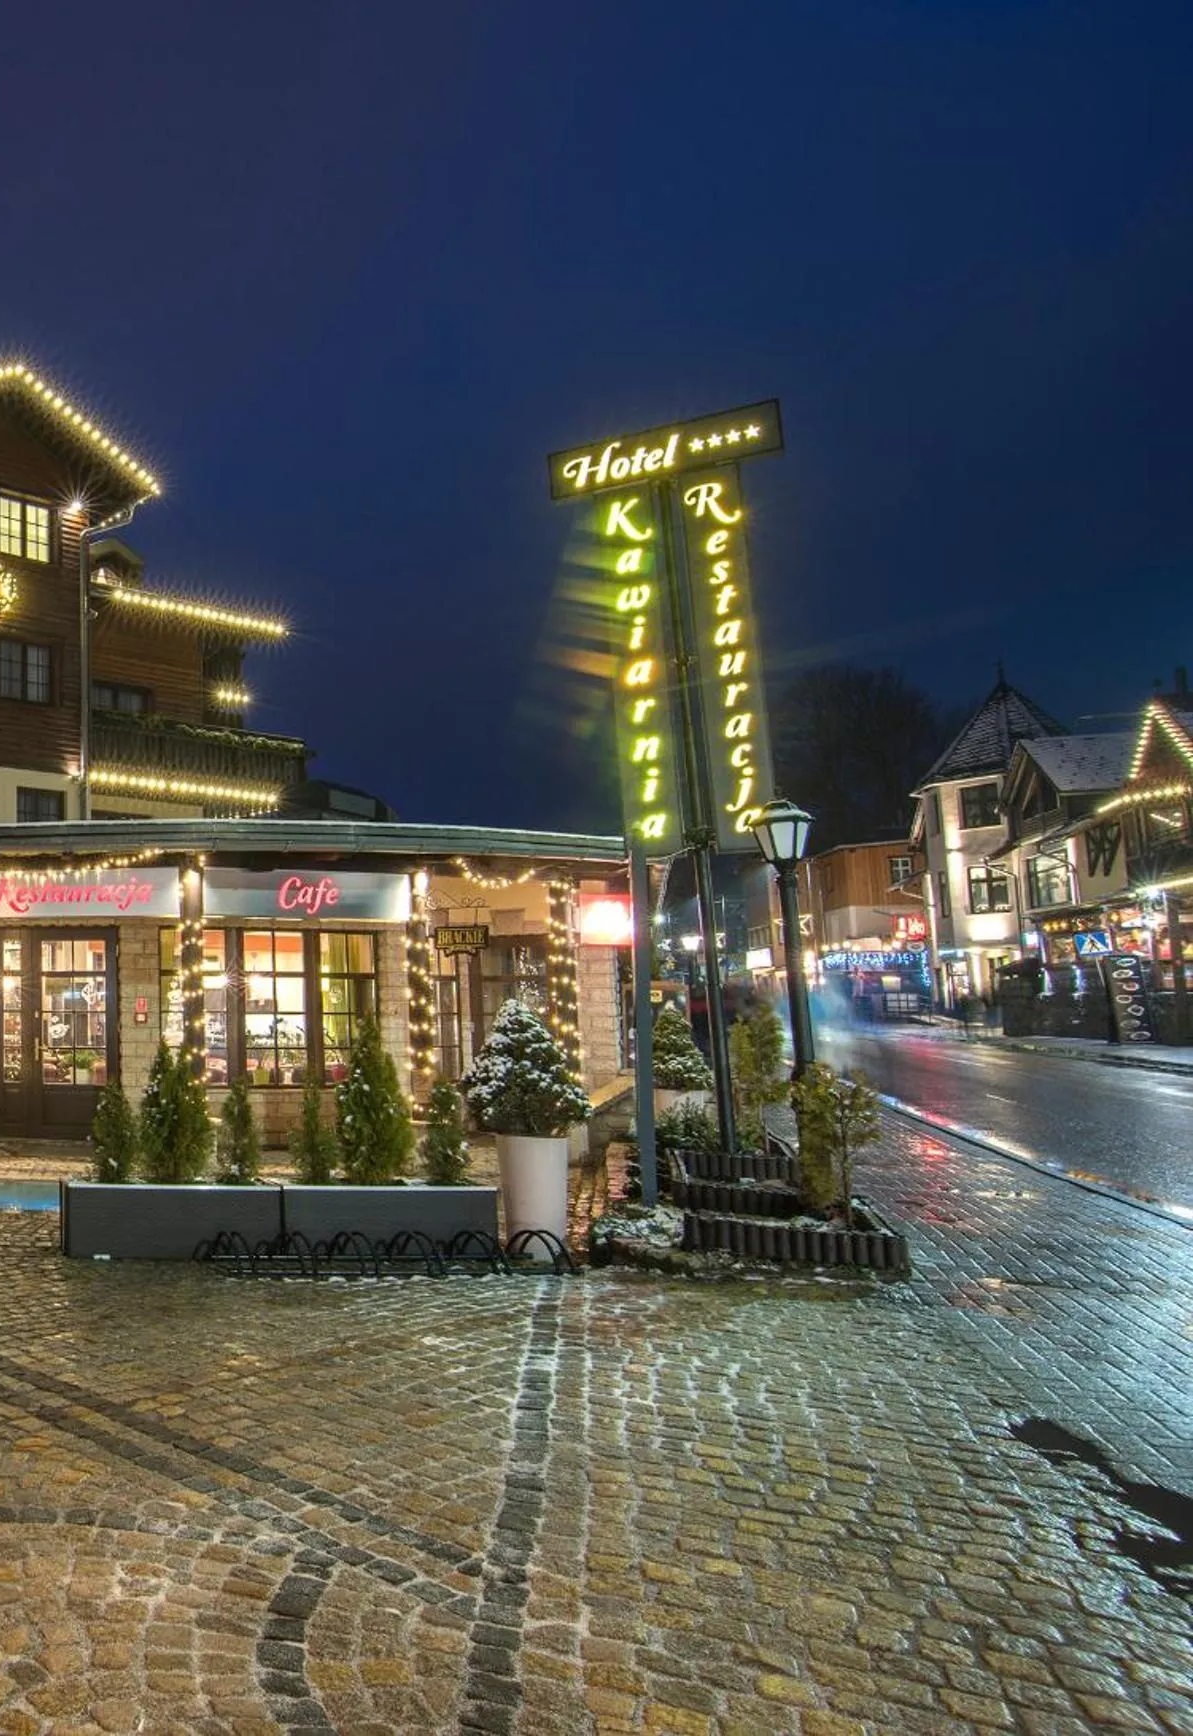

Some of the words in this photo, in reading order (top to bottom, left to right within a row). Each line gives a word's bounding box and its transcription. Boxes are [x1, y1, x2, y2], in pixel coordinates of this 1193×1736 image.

[563, 434, 679, 489] Hotel
[606, 498, 668, 839] Kawiarnia
[684, 482, 763, 833] Restauracja
[279, 877, 339, 914] Cafe
